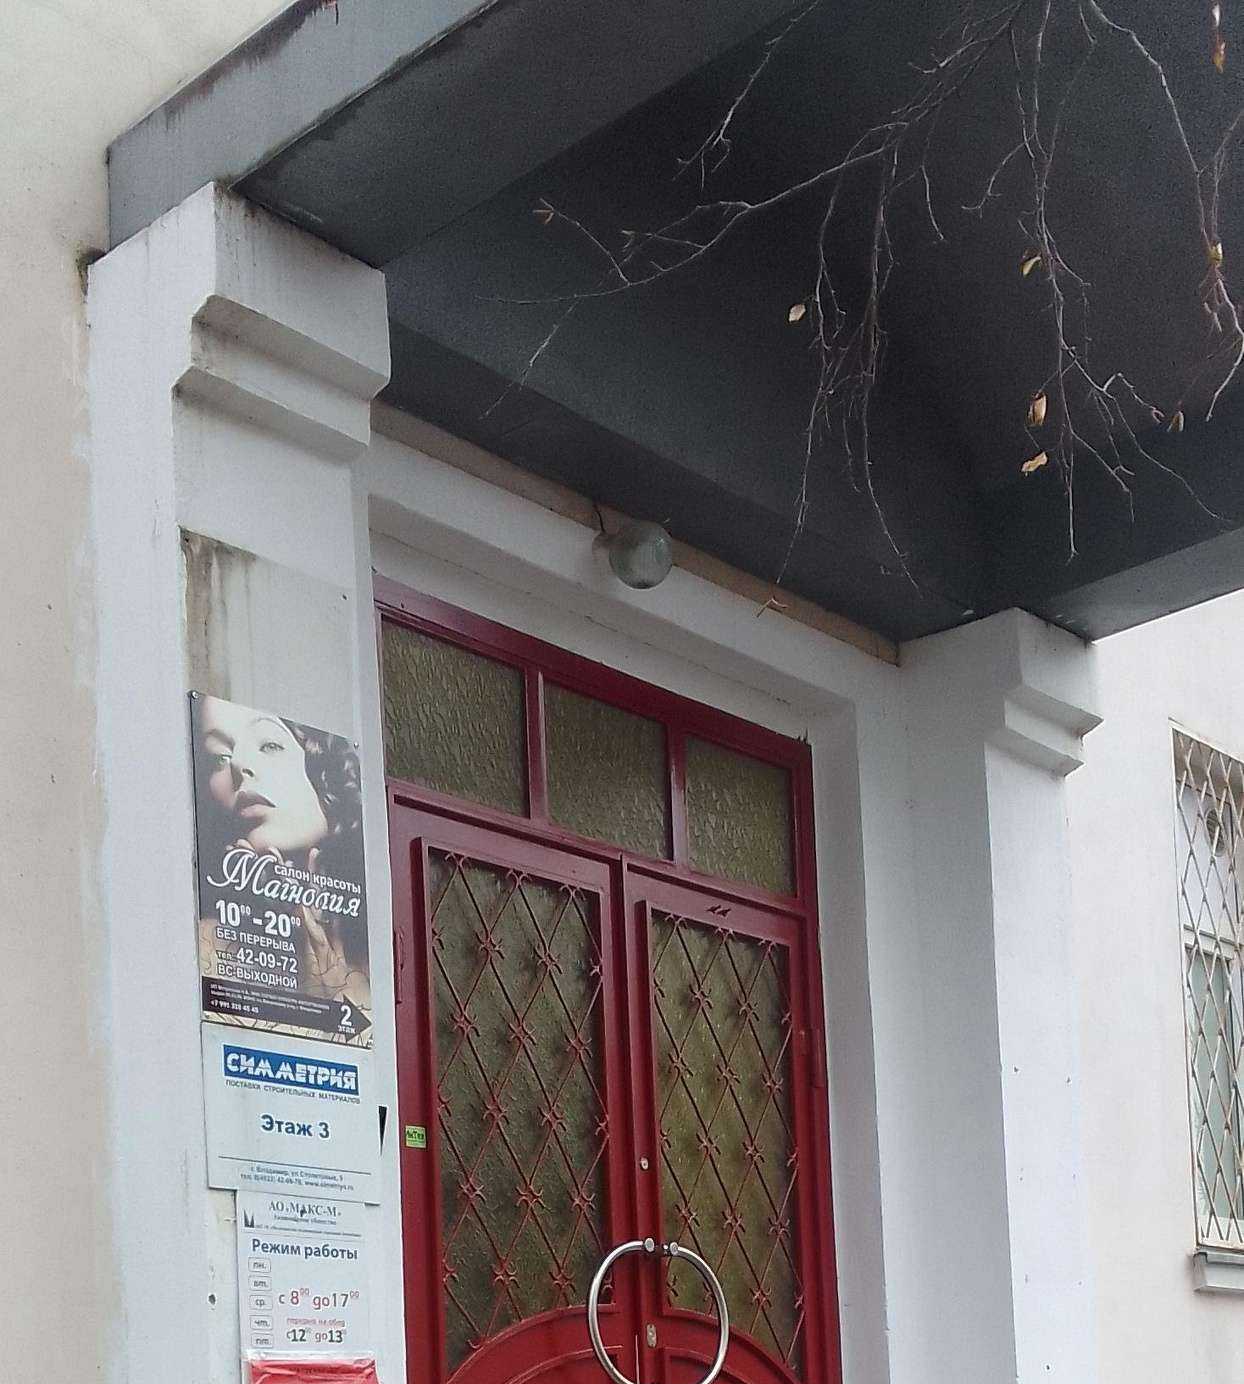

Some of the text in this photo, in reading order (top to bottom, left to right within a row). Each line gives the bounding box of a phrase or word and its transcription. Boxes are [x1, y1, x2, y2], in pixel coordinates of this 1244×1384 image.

[207, 848, 361, 917] Магнолия
[274, 864, 361, 894] салон красоты
[216, 927, 296, 953] БЕЗ ПЕРЕРЫВА
[237, 948, 298, 973] 42-09-72
[340, 1004, 352, 1027] 2
[226, 1052, 357, 1091] СИММЕТРИЯ
[260, 1113, 330, 1139] Этаж 3
[269, 1200, 285, 1212] АО
[252, 1238, 358, 1259] Режим работы
